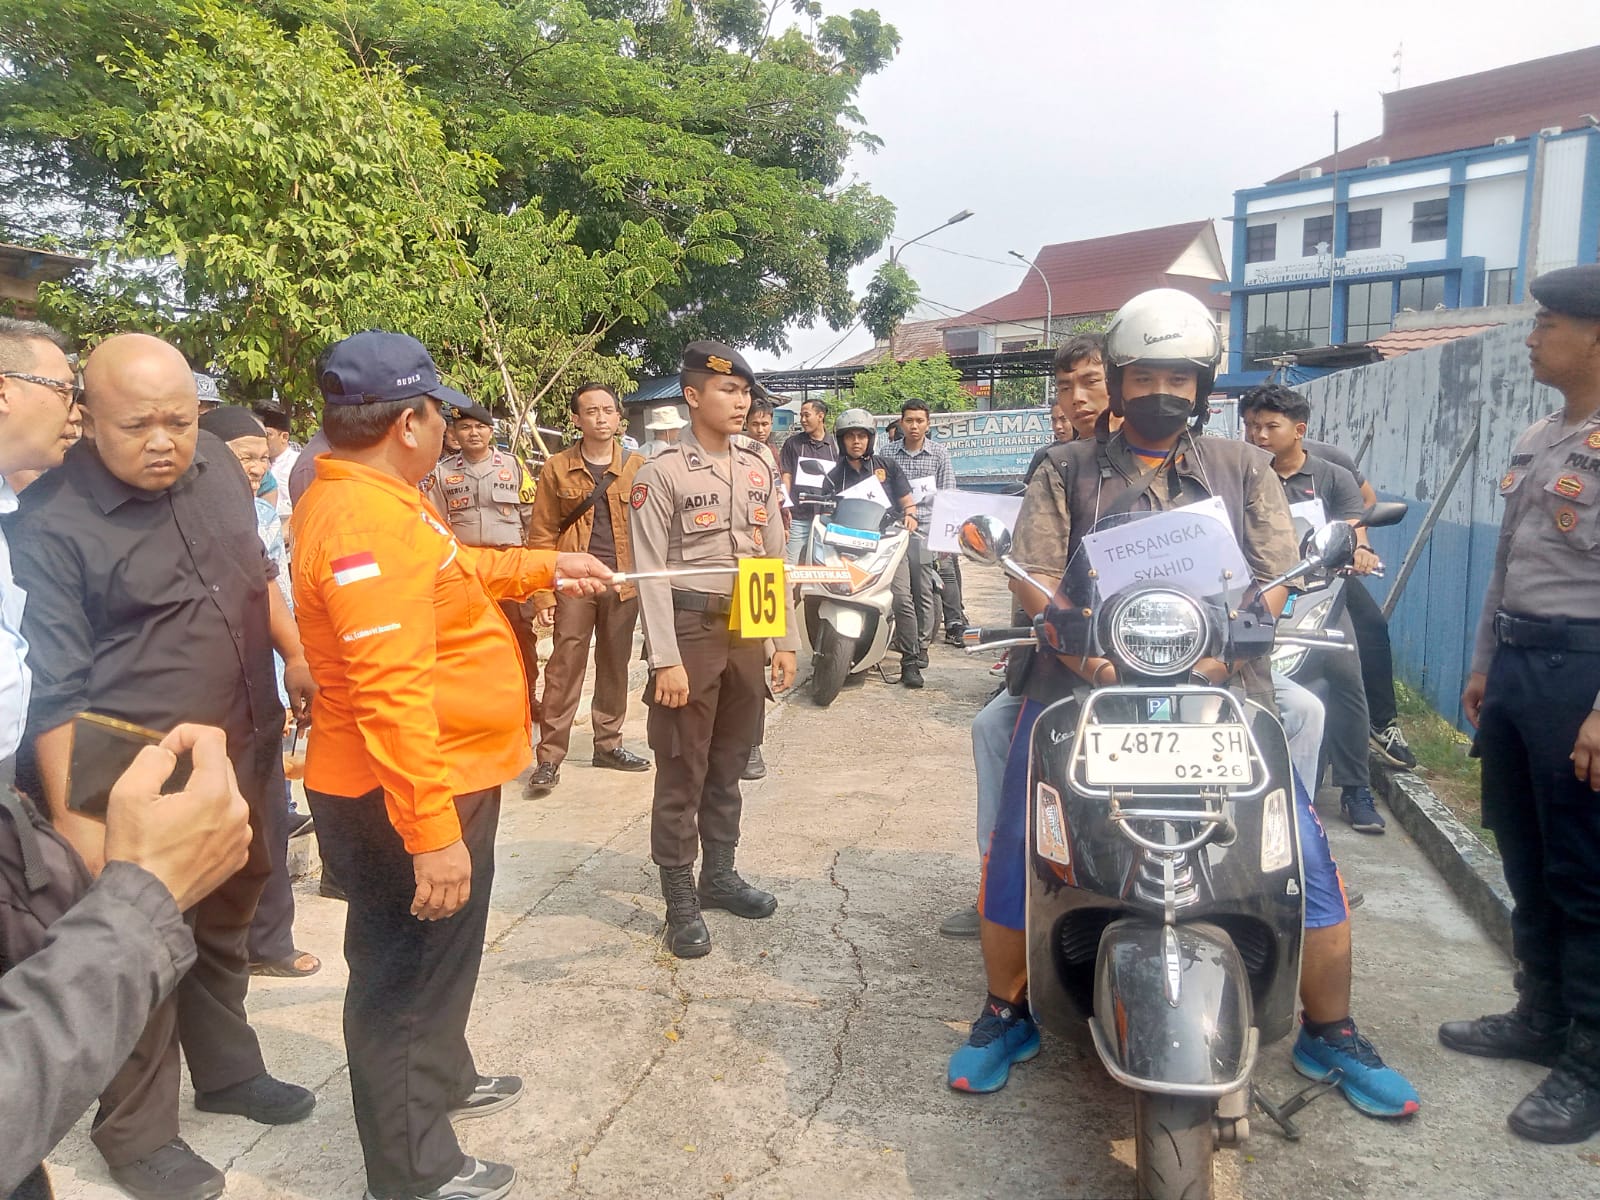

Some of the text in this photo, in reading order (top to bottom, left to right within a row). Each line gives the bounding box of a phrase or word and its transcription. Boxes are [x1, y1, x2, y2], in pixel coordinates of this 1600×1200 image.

[980, 436, 995, 447] UJI
[998, 435, 1042, 446] PRAKTEK
[1045, 433, 1056, 443] SI
[493, 482, 518, 491] POLRI
[943, 523, 961, 539] PA
[1104, 523, 1207, 562] TERSANGKA
[1134, 557, 1195, 582] SYAHID
[748, 571, 777, 625] 05
[1090, 732, 1103, 754] T
[1212, 731, 1244, 754] SH
